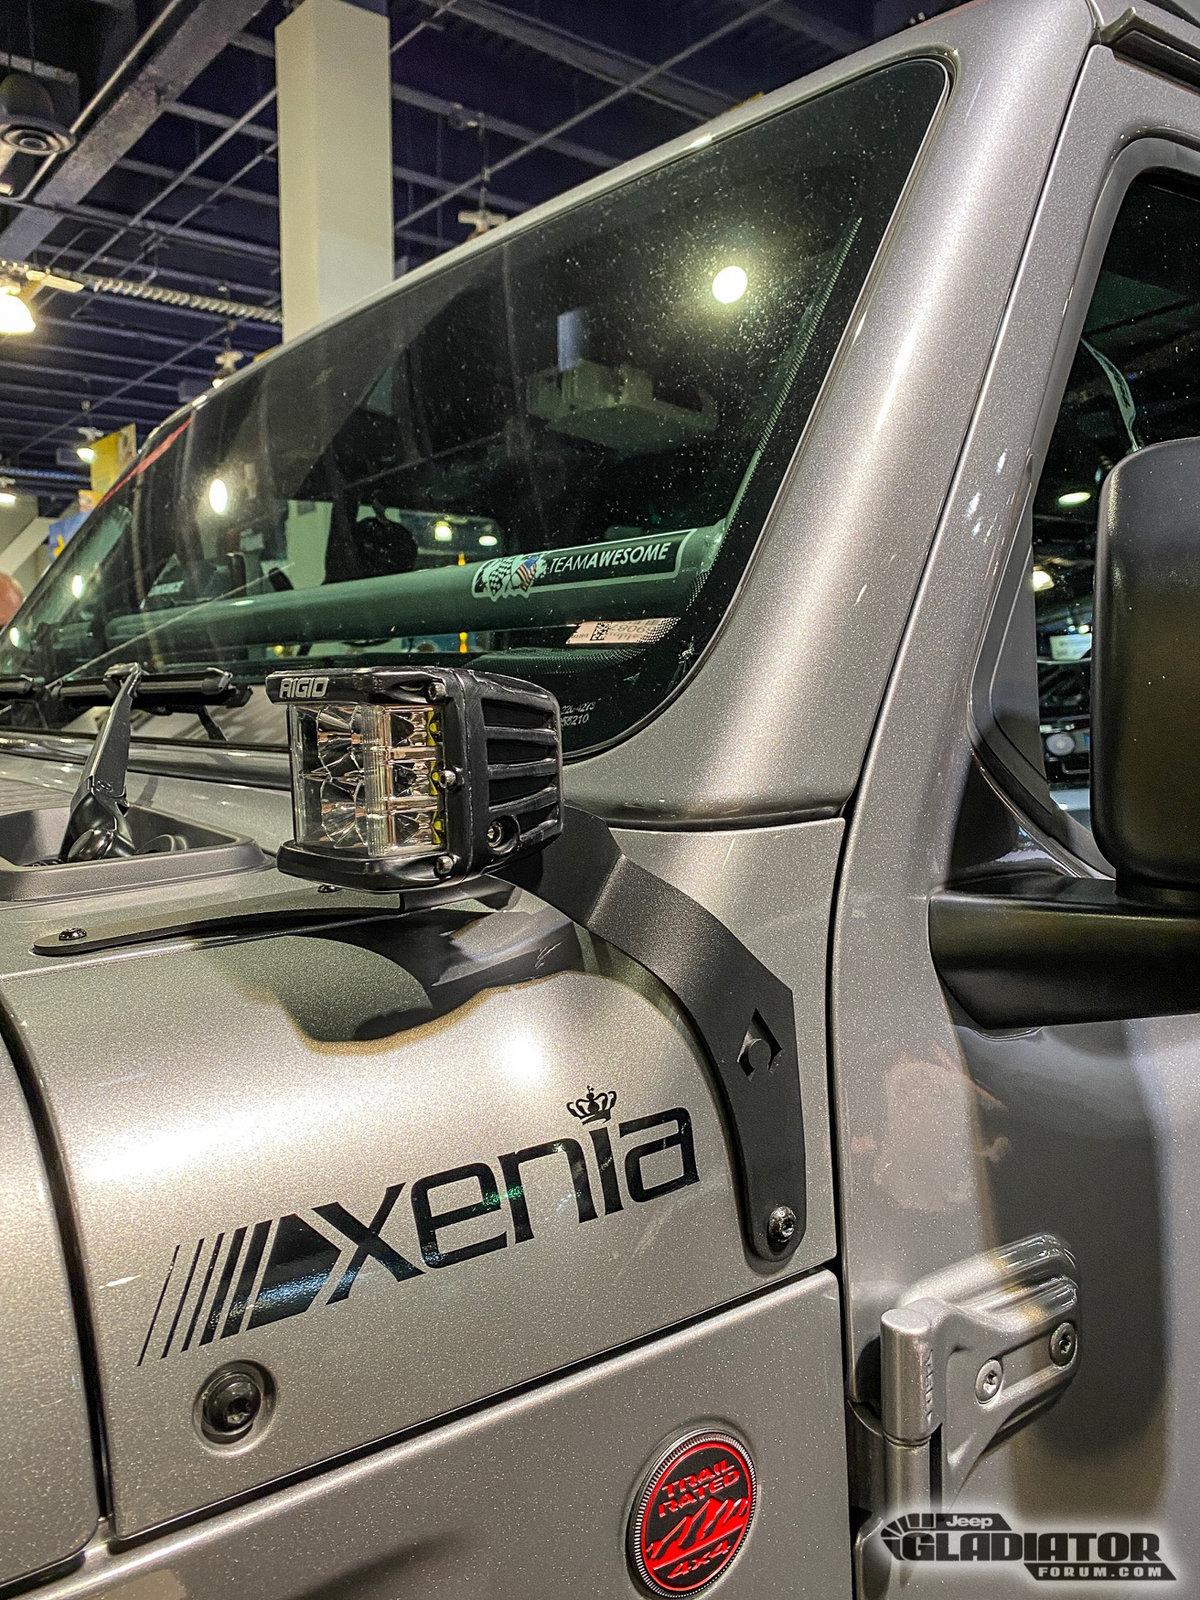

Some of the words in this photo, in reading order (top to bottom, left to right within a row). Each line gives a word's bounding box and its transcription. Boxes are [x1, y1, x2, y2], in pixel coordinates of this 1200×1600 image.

[548, 542, 671, 573] TEAMAWESOME
[279, 677, 329, 698] RIGID
[312, 1106, 700, 1306] xenia
[658, 1470, 740, 1518] RATED
[661, 1459, 735, 1499] TRAIL
